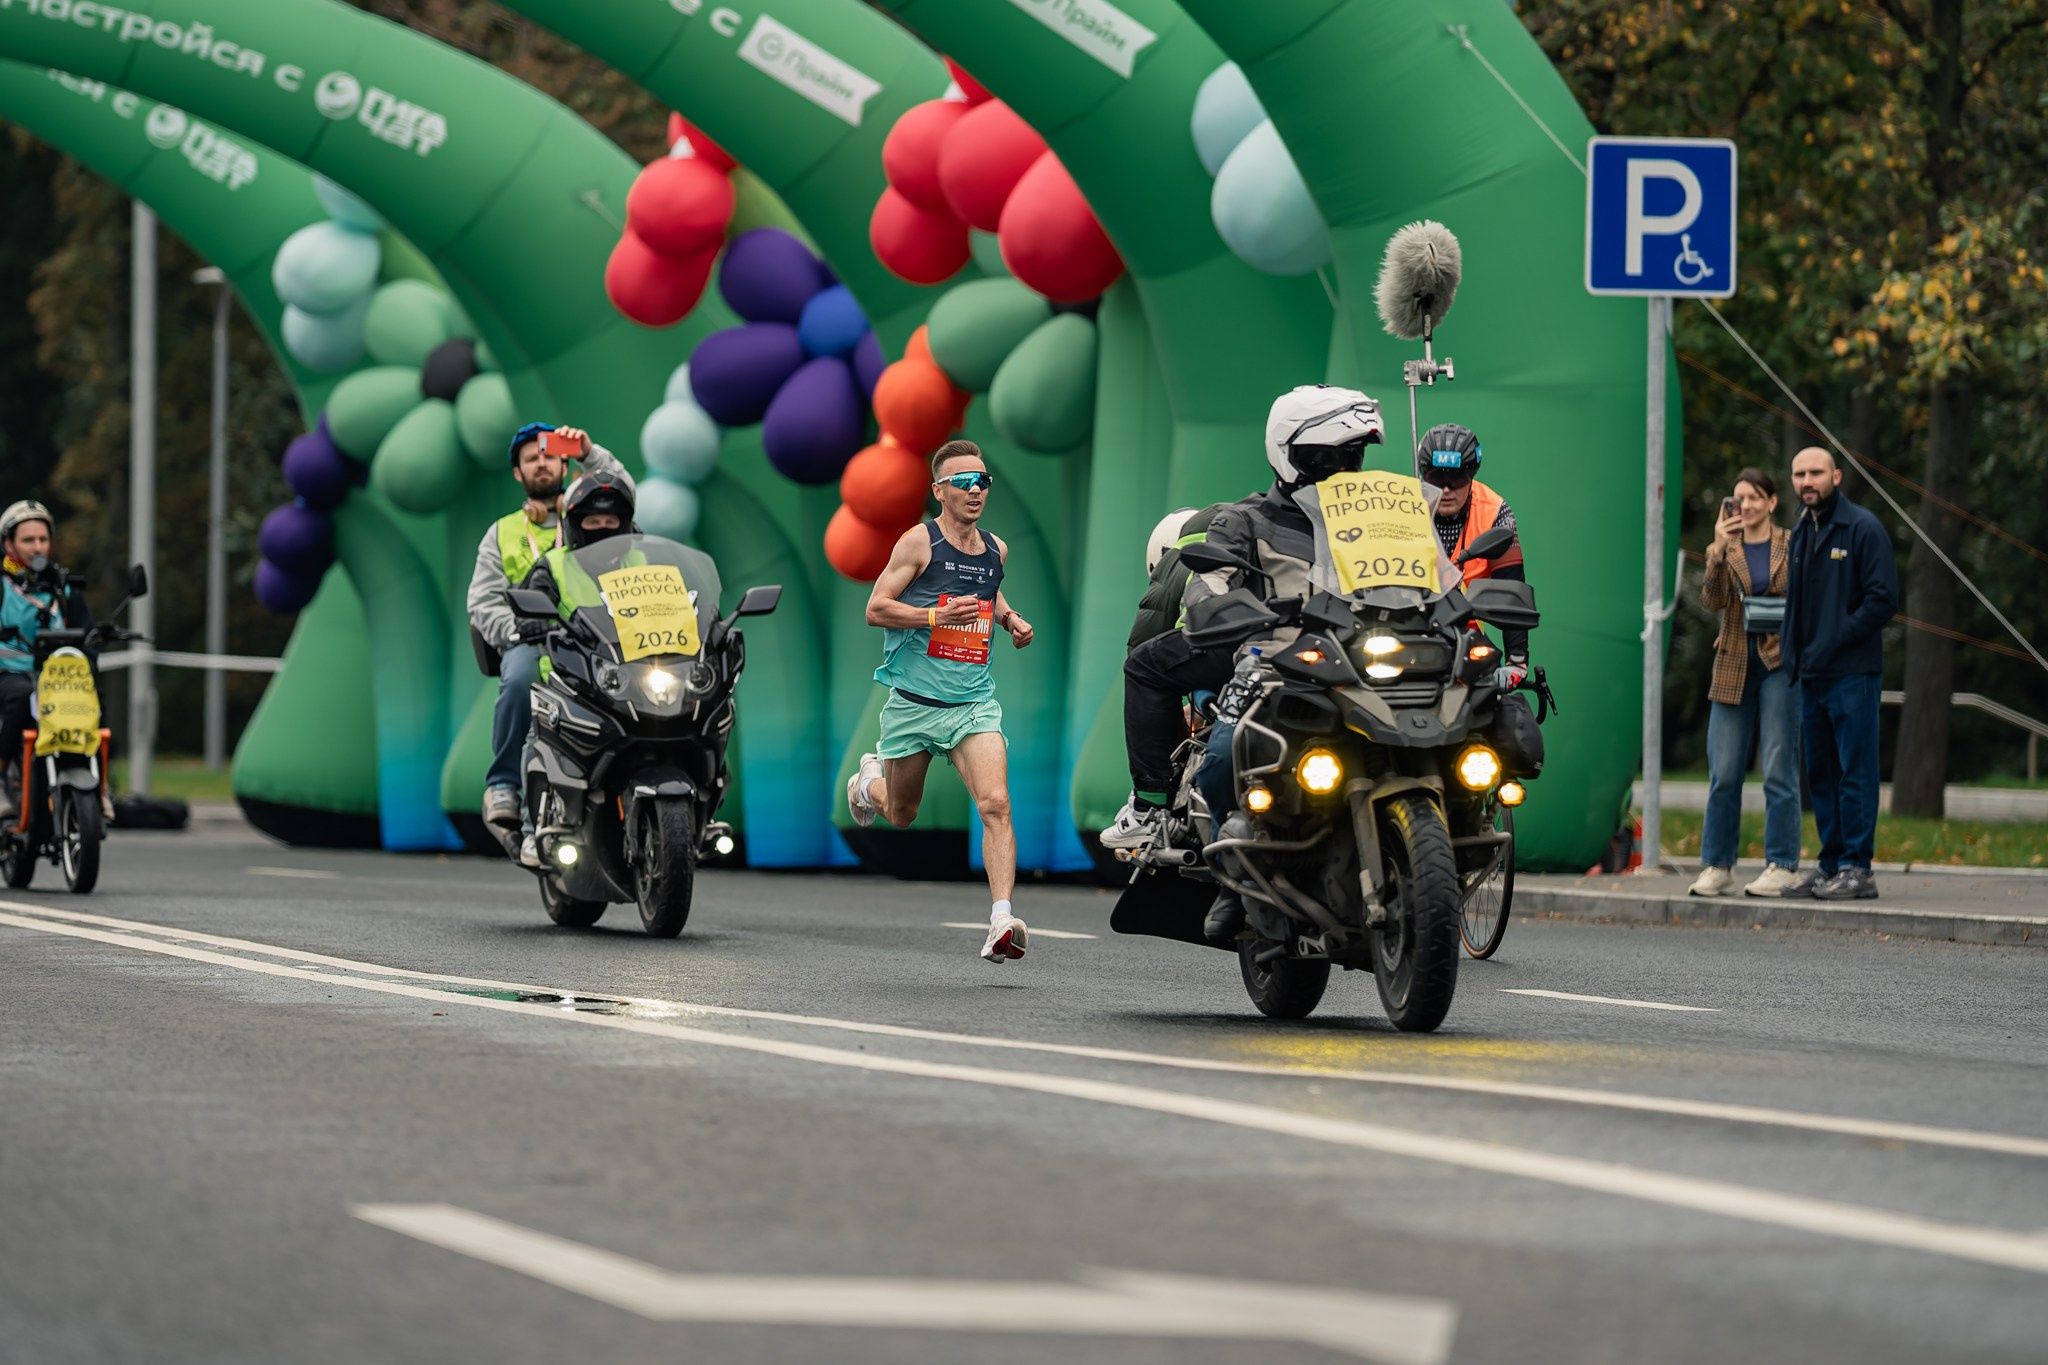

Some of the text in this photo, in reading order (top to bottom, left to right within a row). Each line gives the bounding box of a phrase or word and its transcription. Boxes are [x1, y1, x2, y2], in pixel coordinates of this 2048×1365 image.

[709, 7, 742, 38] с
[274, 63, 304, 91] с
[1625, 158, 1702, 277] P
[1331, 481, 1414, 499] ТРАССА
[1326, 497, 1425, 518] ПРОПУСК
[1354, 557, 1426, 579] 2026
[612, 572, 674, 588] ТРАССА
[609, 584, 685, 600] ПРОПУСК
[634, 630, 688, 650] 2026
